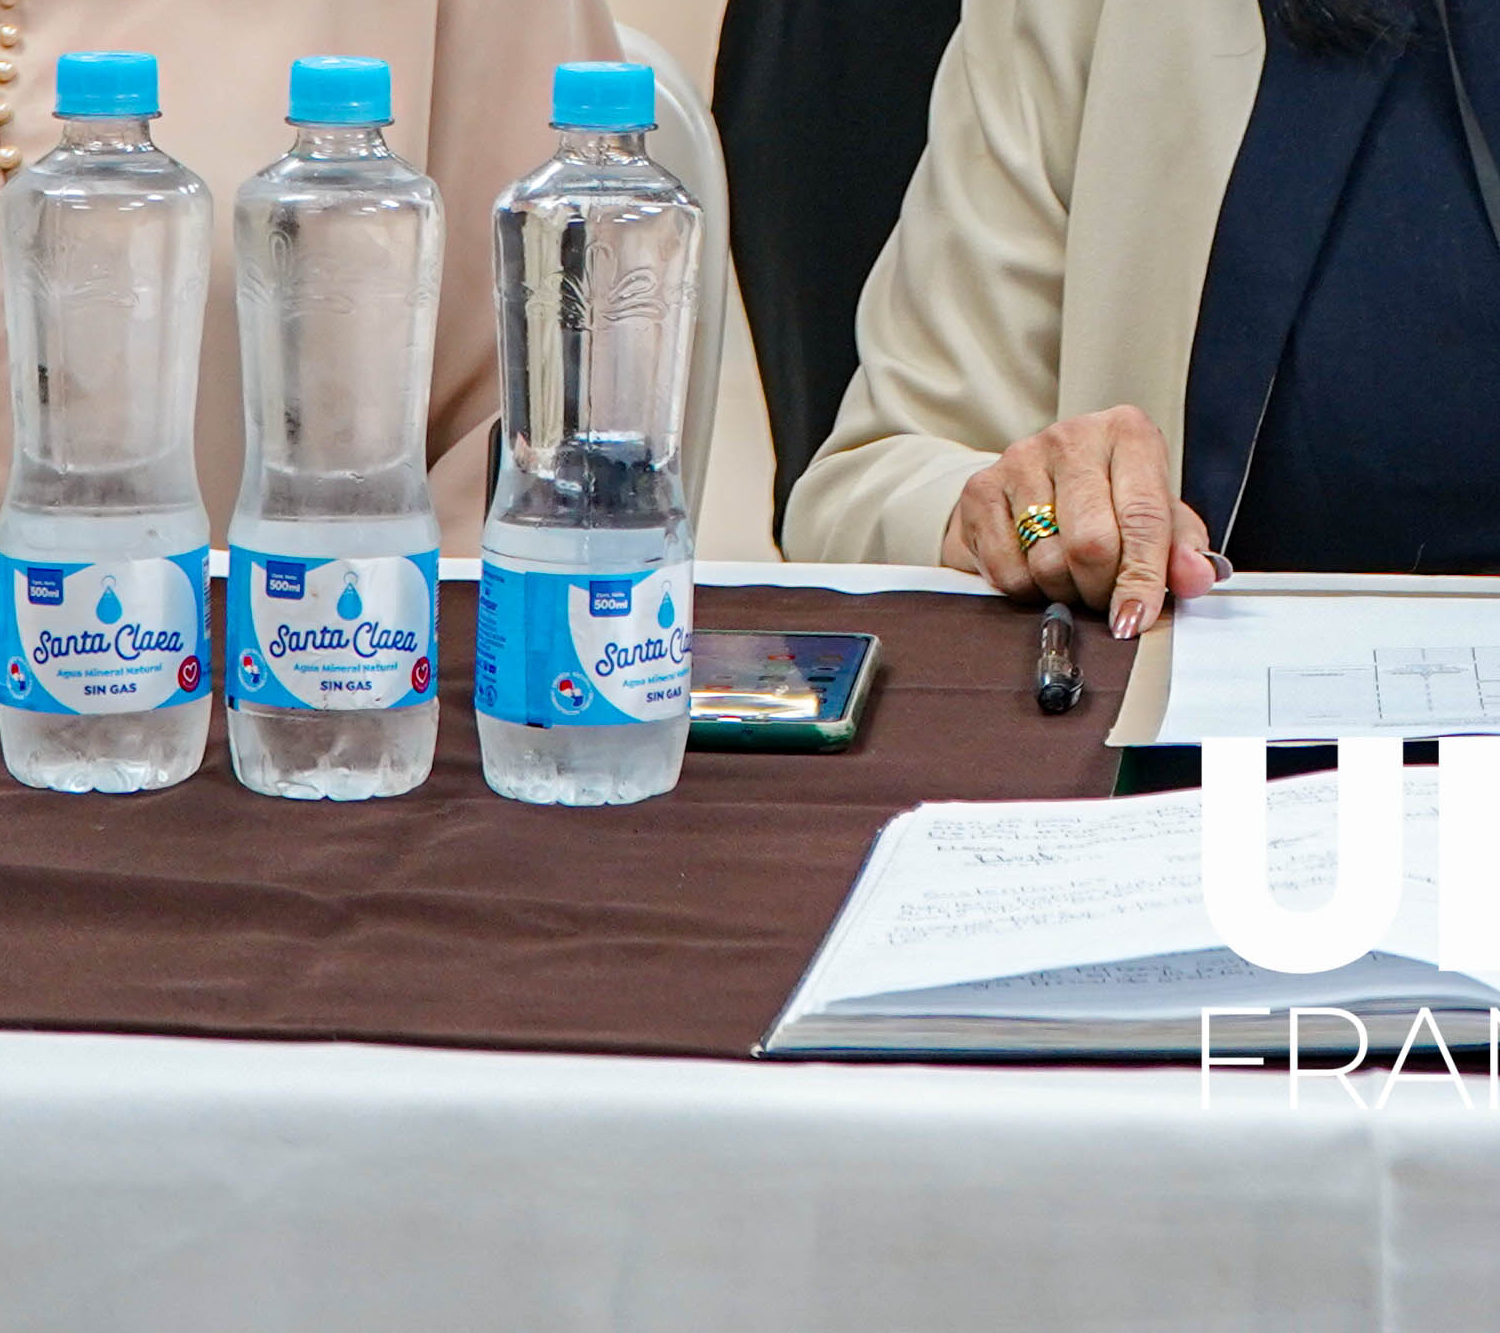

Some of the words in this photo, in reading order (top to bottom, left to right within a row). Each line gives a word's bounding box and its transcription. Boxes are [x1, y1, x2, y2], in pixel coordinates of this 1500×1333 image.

[30, 586, 60, 599] 500ml
[269, 580, 301, 593] 500ml
[594, 599, 628, 611] 500ml
[33, 630, 111, 664] Santa
[115, 623, 184, 661] Clara
[270, 624, 349, 658] Santa
[353, 621, 418, 658] Clara
[595, 638, 668, 677] Santa
[669, 626, 693, 664] Cla
[84, 667, 124, 678] Mineral
[84, 684, 106, 696] SIN
[109, 683, 137, 695] GAS
[320, 681, 343, 692] SIN
[345, 681, 373, 692] GAS
[646, 690, 665, 703] SIN
[666, 686, 682, 700] GAS
